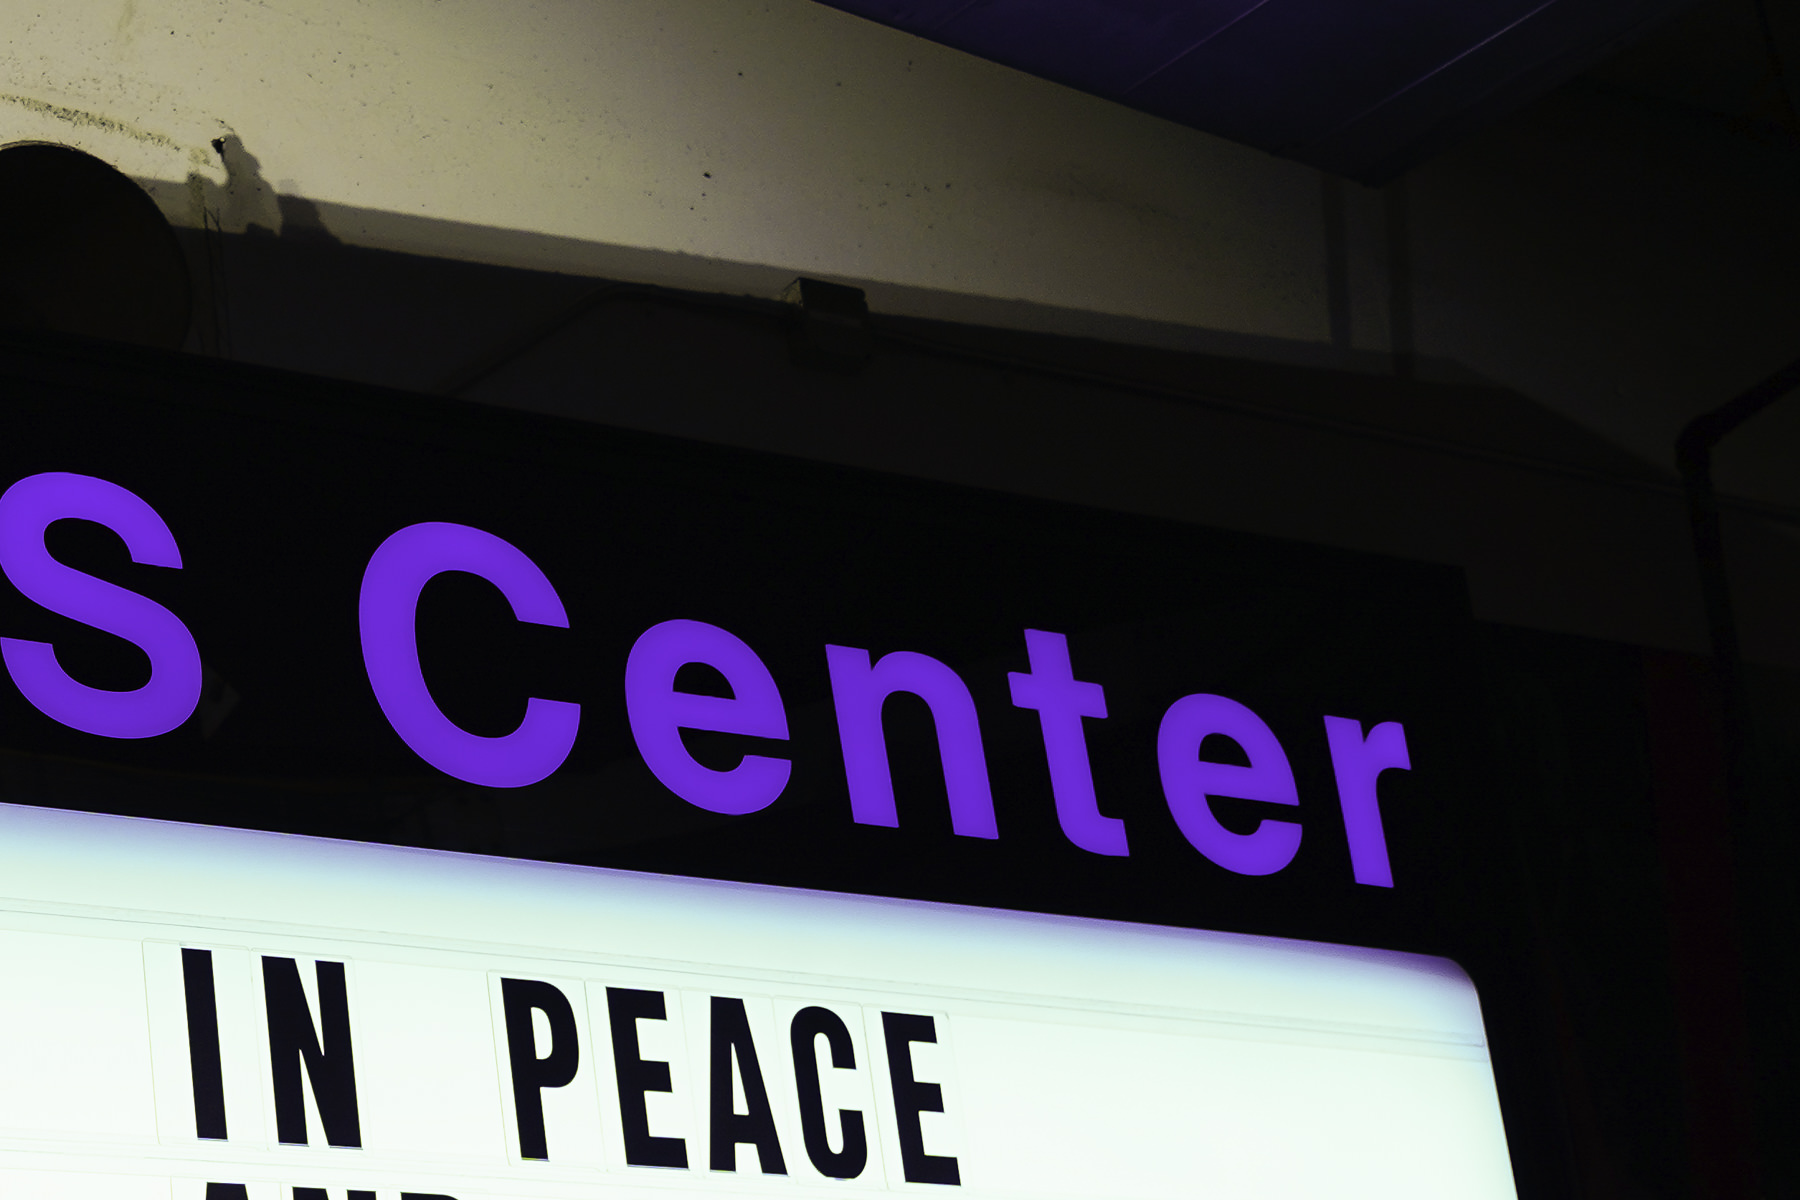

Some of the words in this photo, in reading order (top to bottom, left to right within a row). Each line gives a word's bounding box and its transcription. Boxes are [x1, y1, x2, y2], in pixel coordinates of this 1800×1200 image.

[357, 520, 1412, 889] Center
[179, 946, 363, 1149] IN
[500, 976, 963, 1187] PEACE
